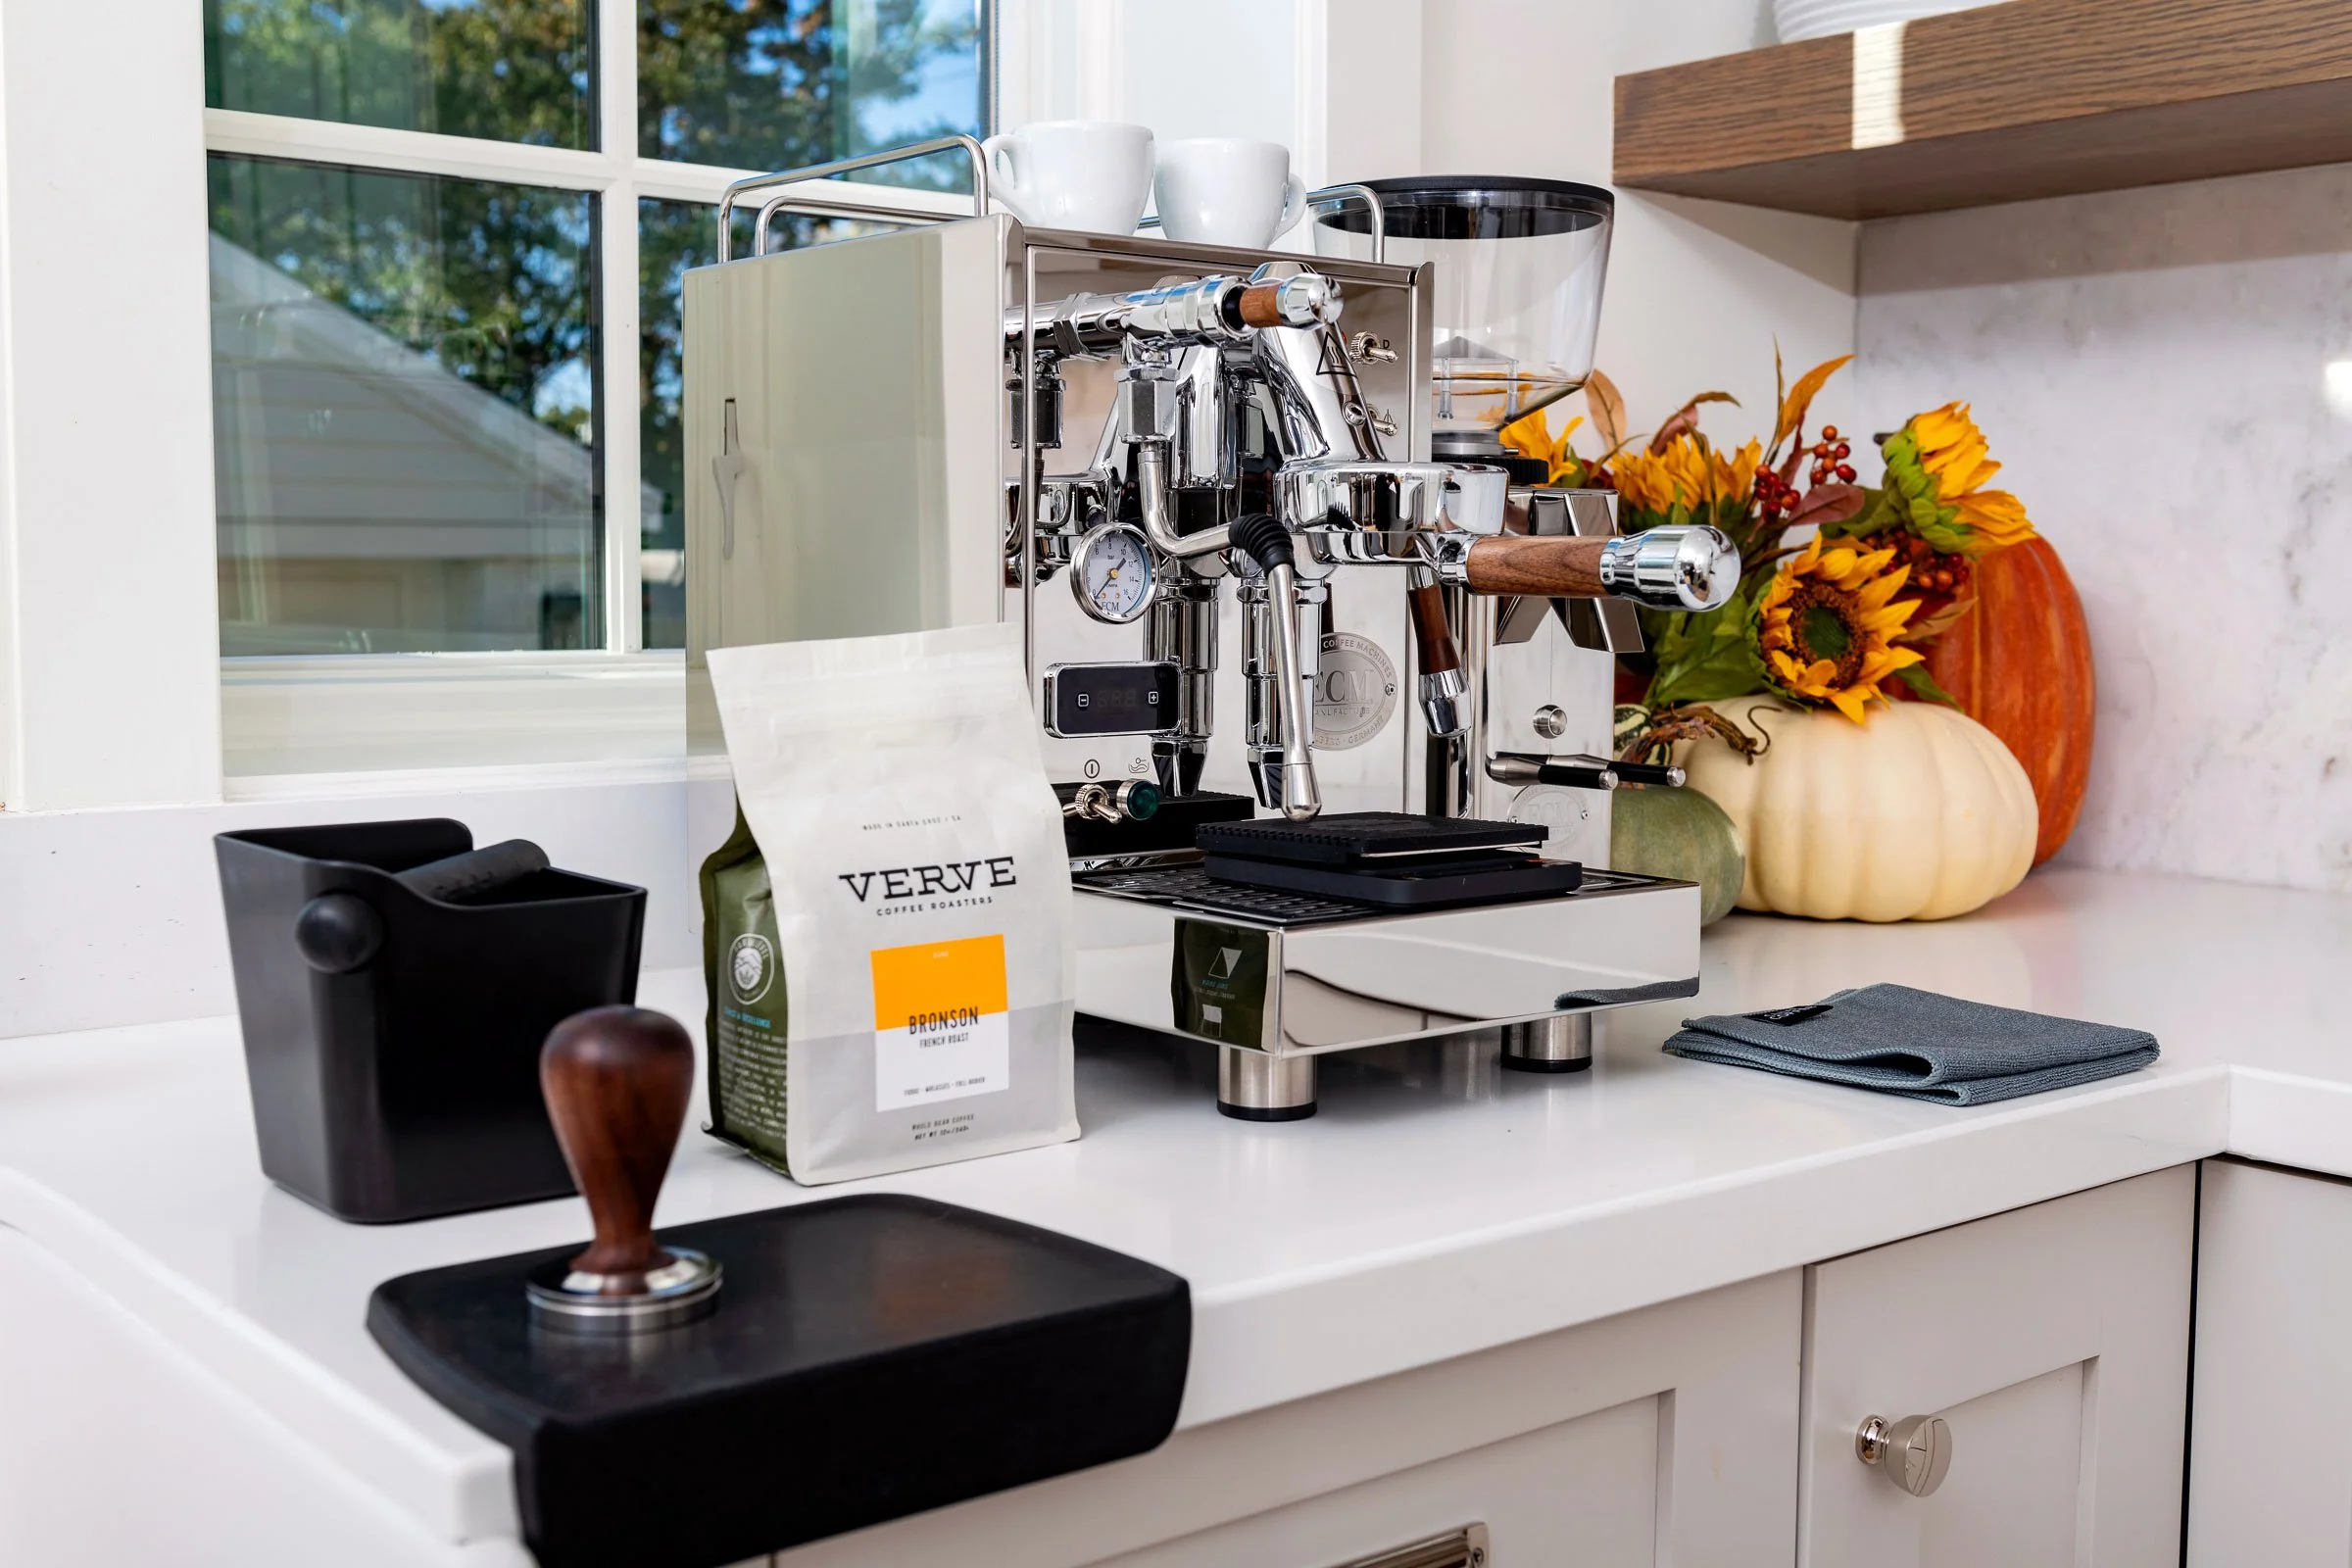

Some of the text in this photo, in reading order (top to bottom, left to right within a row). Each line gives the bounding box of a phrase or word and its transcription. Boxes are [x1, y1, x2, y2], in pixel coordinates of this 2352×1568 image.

[1323, 639, 1393, 678] COFFEE MACHINES
[1348, 716, 1385, 744] GERMANY
[839, 856, 1016, 902] VERVE
[876, 896, 994, 916] COFFEE ROASTERS
[909, 1005, 979, 1035] BRONSON
[919, 1032, 969, 1049] FRENCH ROAST
[953, 1113, 975, 1124] COFFEE
